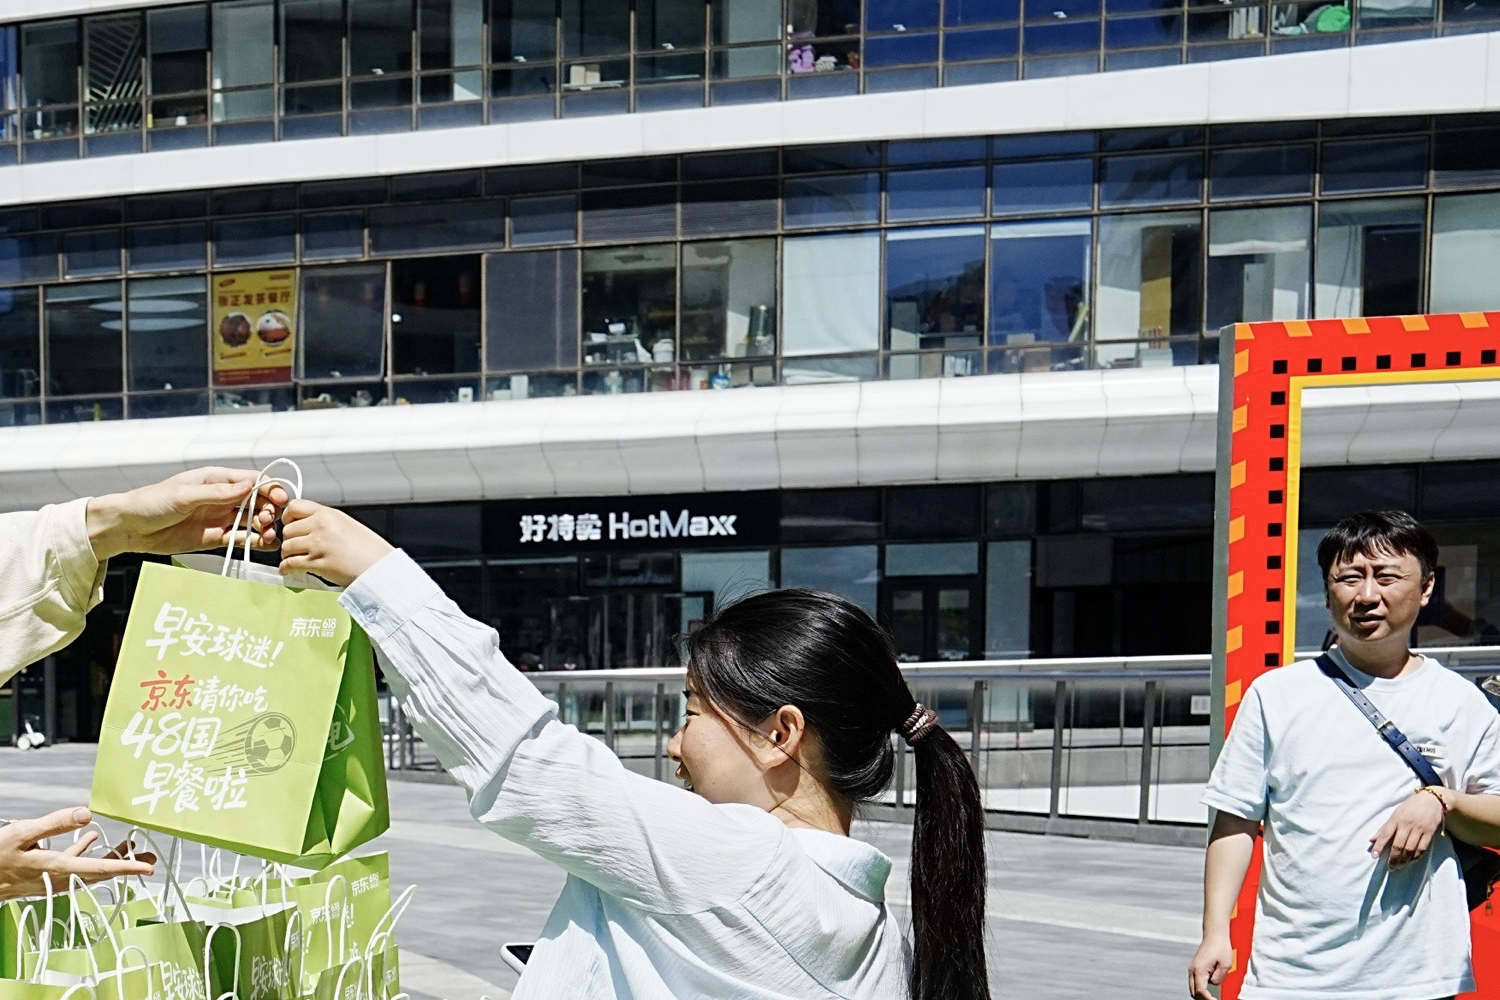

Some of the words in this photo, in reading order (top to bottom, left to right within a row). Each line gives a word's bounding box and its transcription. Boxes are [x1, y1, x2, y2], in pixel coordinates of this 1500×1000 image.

[519, 513, 602, 543] 好特卖
[608, 509, 738, 540] HotMaxx
[145, 602, 284, 668] 早安球迷!
[140, 669, 268, 713] 京东请你吃
[120, 711, 222, 759] 48国
[131, 760, 248, 815] 早餐啦
